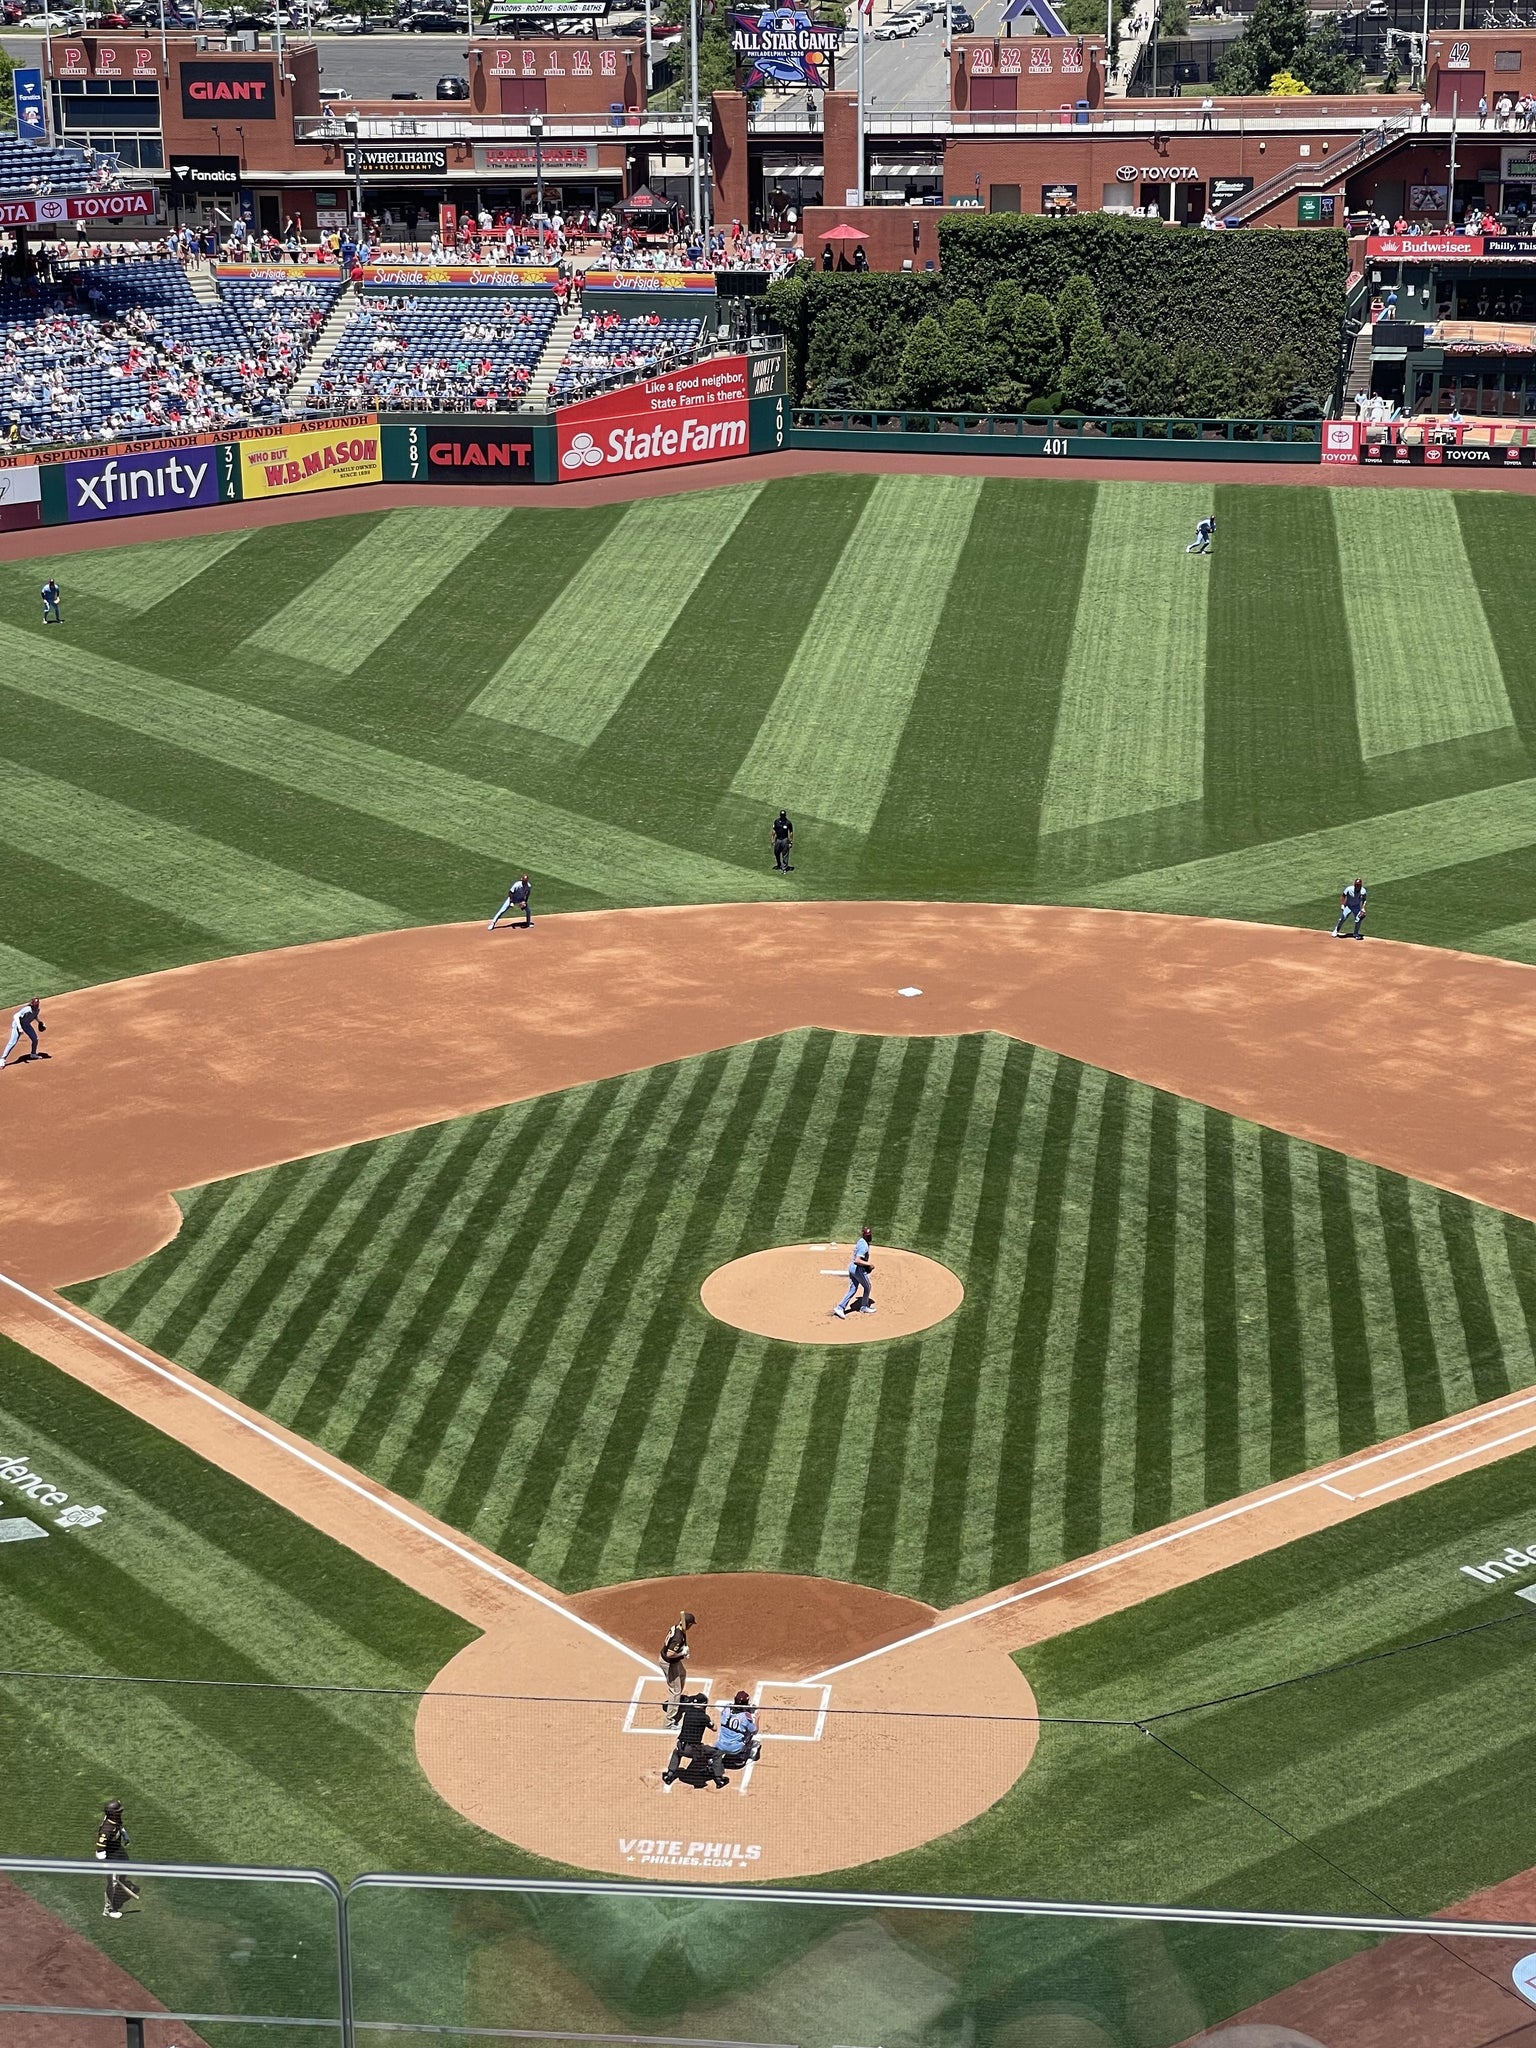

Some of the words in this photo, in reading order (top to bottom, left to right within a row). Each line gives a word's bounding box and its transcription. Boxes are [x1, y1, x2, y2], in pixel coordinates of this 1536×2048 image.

[732, 30, 760, 50] ALL
[761, 30, 798, 50] STAR
[799, 30, 838, 50] GAME
[65, 49, 80, 68] P
[100, 49, 116, 68] P
[136, 49, 151, 68] P
[497, 50, 511, 69] P
[549, 50, 558, 69] 1
[573, 51, 591, 69] 14
[600, 51, 616, 69] 15
[973, 49, 993, 67] 20
[1000, 48, 1020, 67] 32
[1031, 48, 1052, 67] 34
[1062, 48, 1082, 67] 36
[1450, 42, 1470, 62] 42
[188, 81, 266, 99] GIANT
[486, 149, 528, 158] TONY
[190, 169, 237, 181] Fanatics
[1140, 167, 1199, 180] TOYOTA
[73, 195, 148, 216] TOYOTA
[1489, 241, 1517, 251] Philly,
[250, 267, 287, 279] Surfside
[374, 268, 424, 284] Surfside
[470, 268, 520, 285] Surfside
[613, 273, 660, 289] Surfside
[645, 381, 666, 394] Like
[668, 382, 675, 391] a
[676, 377, 699, 392] good
[702, 373, 745, 387] neighbor,
[755, 376, 774, 395] ANGLE
[651, 398, 677, 410] State
[680, 394, 705, 406] Farm
[707, 393, 715, 403] is
[300, 415, 368, 433] ASPLUNDH
[775, 398, 783, 448] 409
[212, 426, 283, 443] ASPLUNDH
[124, 437, 198, 454] ASPLUNDH
[408, 427, 419, 479] 387
[429, 443, 532, 465] GIANT
[1043, 439, 1068, 455] 401
[33, 446, 109, 465] ASPLUNDH
[248, 452, 269, 464] WHO
[271, 449, 288, 461] BUT
[1321, 453, 1358, 462] TOYOTA
[1446, 450, 1491, 461] TOYOTA
[225, 446, 235, 498] 374
[333, 465, 355, 474] FAMILY
[355, 463, 377, 471] OWNED
[76, 456, 209, 510] xfinity
[618, 1838, 683, 1856] VOTE
[686, 1841, 762, 1860] PHILS
[640, 1855, 733, 1867] PHILLIES.COM
